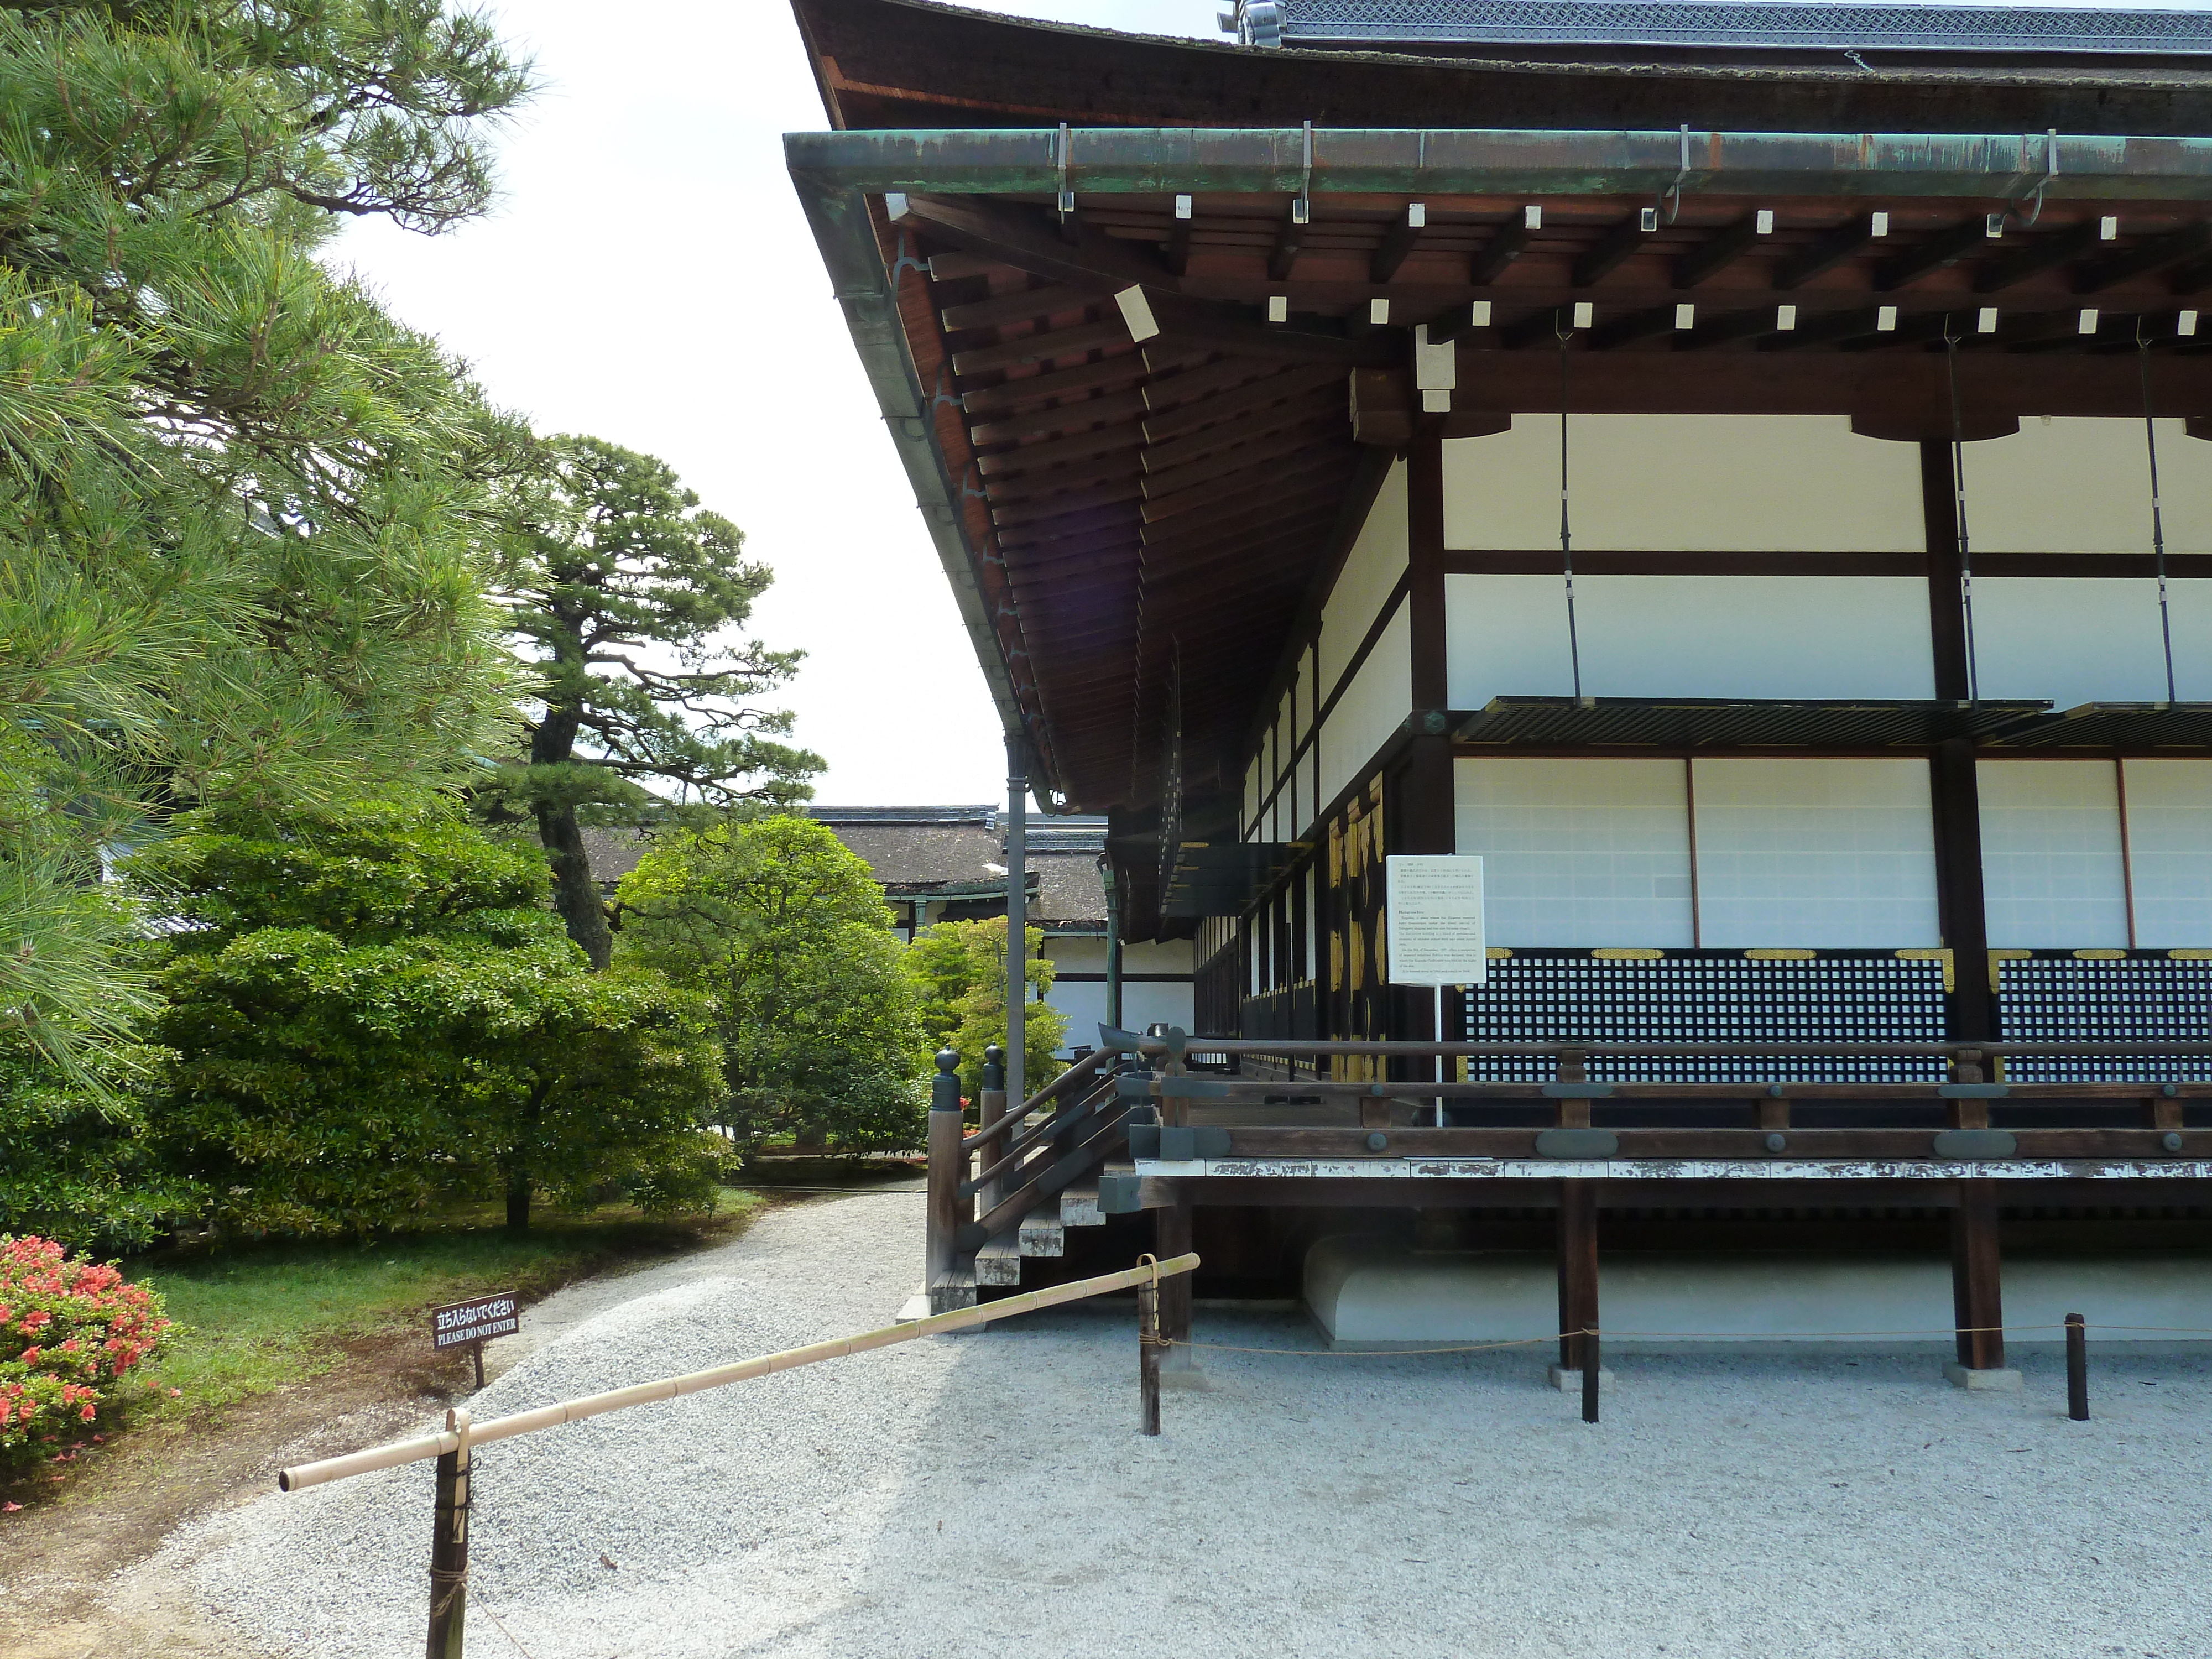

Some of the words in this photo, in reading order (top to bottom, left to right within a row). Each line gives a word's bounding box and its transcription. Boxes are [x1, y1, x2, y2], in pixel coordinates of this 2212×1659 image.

[436, 1299, 515, 1330] 立ち入らないでください
[438, 1329, 465, 1345] PLEASE
[466, 1327, 476, 1339] DO
[477, 1323, 492, 1337] NOT
[493, 1318, 516, 1333] ENTER
